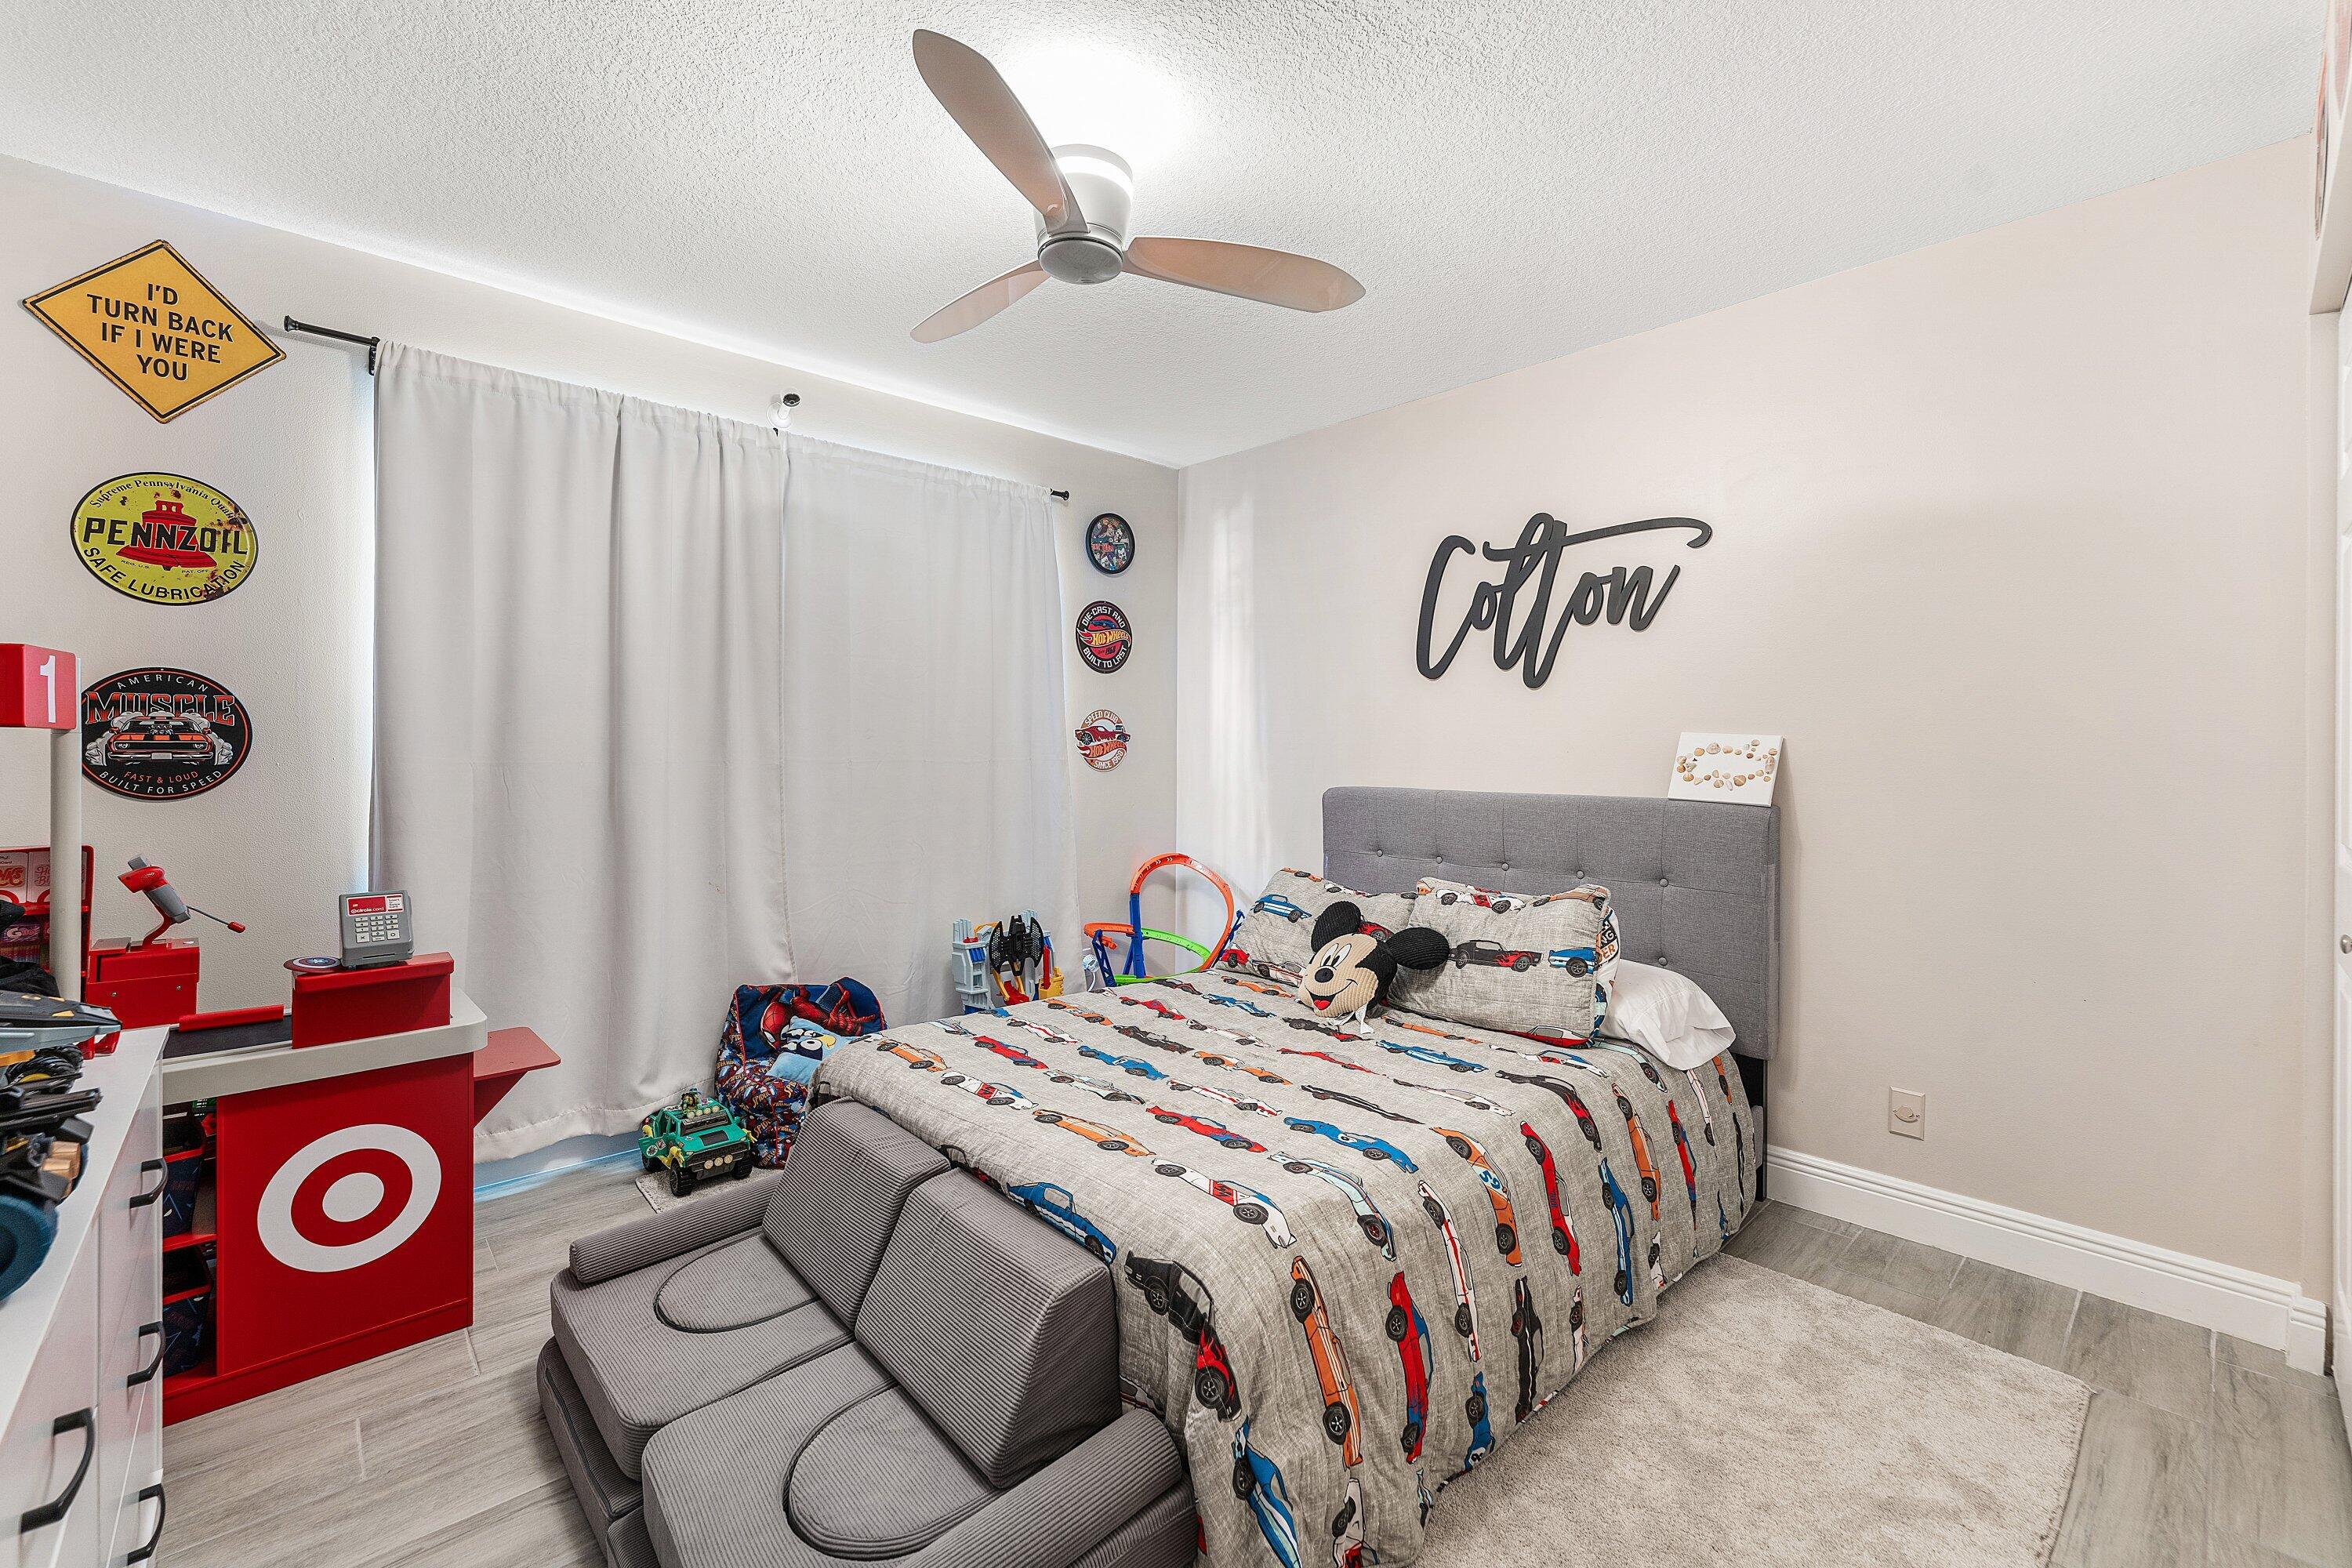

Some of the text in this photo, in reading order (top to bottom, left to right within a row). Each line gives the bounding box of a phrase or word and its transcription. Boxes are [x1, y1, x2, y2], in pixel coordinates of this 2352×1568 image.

[147, 283, 179, 306] I'D
[86, 293, 234, 343] TURN BACK
[101, 321, 222, 365] IF I WERE
[136, 354, 188, 381] YOU
[89, 483, 133, 509] Supreme
[133, 478, 209, 500] Pennsylvania
[82, 517, 249, 555] PENNZOIL
[83, 546, 246, 601] SAFE LUBRICATION
[1112, 611, 1126, 628] AND
[1083, 647, 1102, 666] BUILT
[1112, 644, 1127, 666] LAST
[39, 655, 56, 724] 1
[117, 674, 209, 692] AMERICAN
[85, 691, 236, 727] MUSCLE
[1084, 710, 1119, 727] SPEED CLUB
[1094, 760, 1112, 769] SINCE
[99, 771, 140, 792] BUILT
[183, 770, 222, 792] SPEED
[122, 771, 151, 783] FAST
[169, 771, 199, 783] LOUD
[1479, 1170, 1501, 1190] 59
